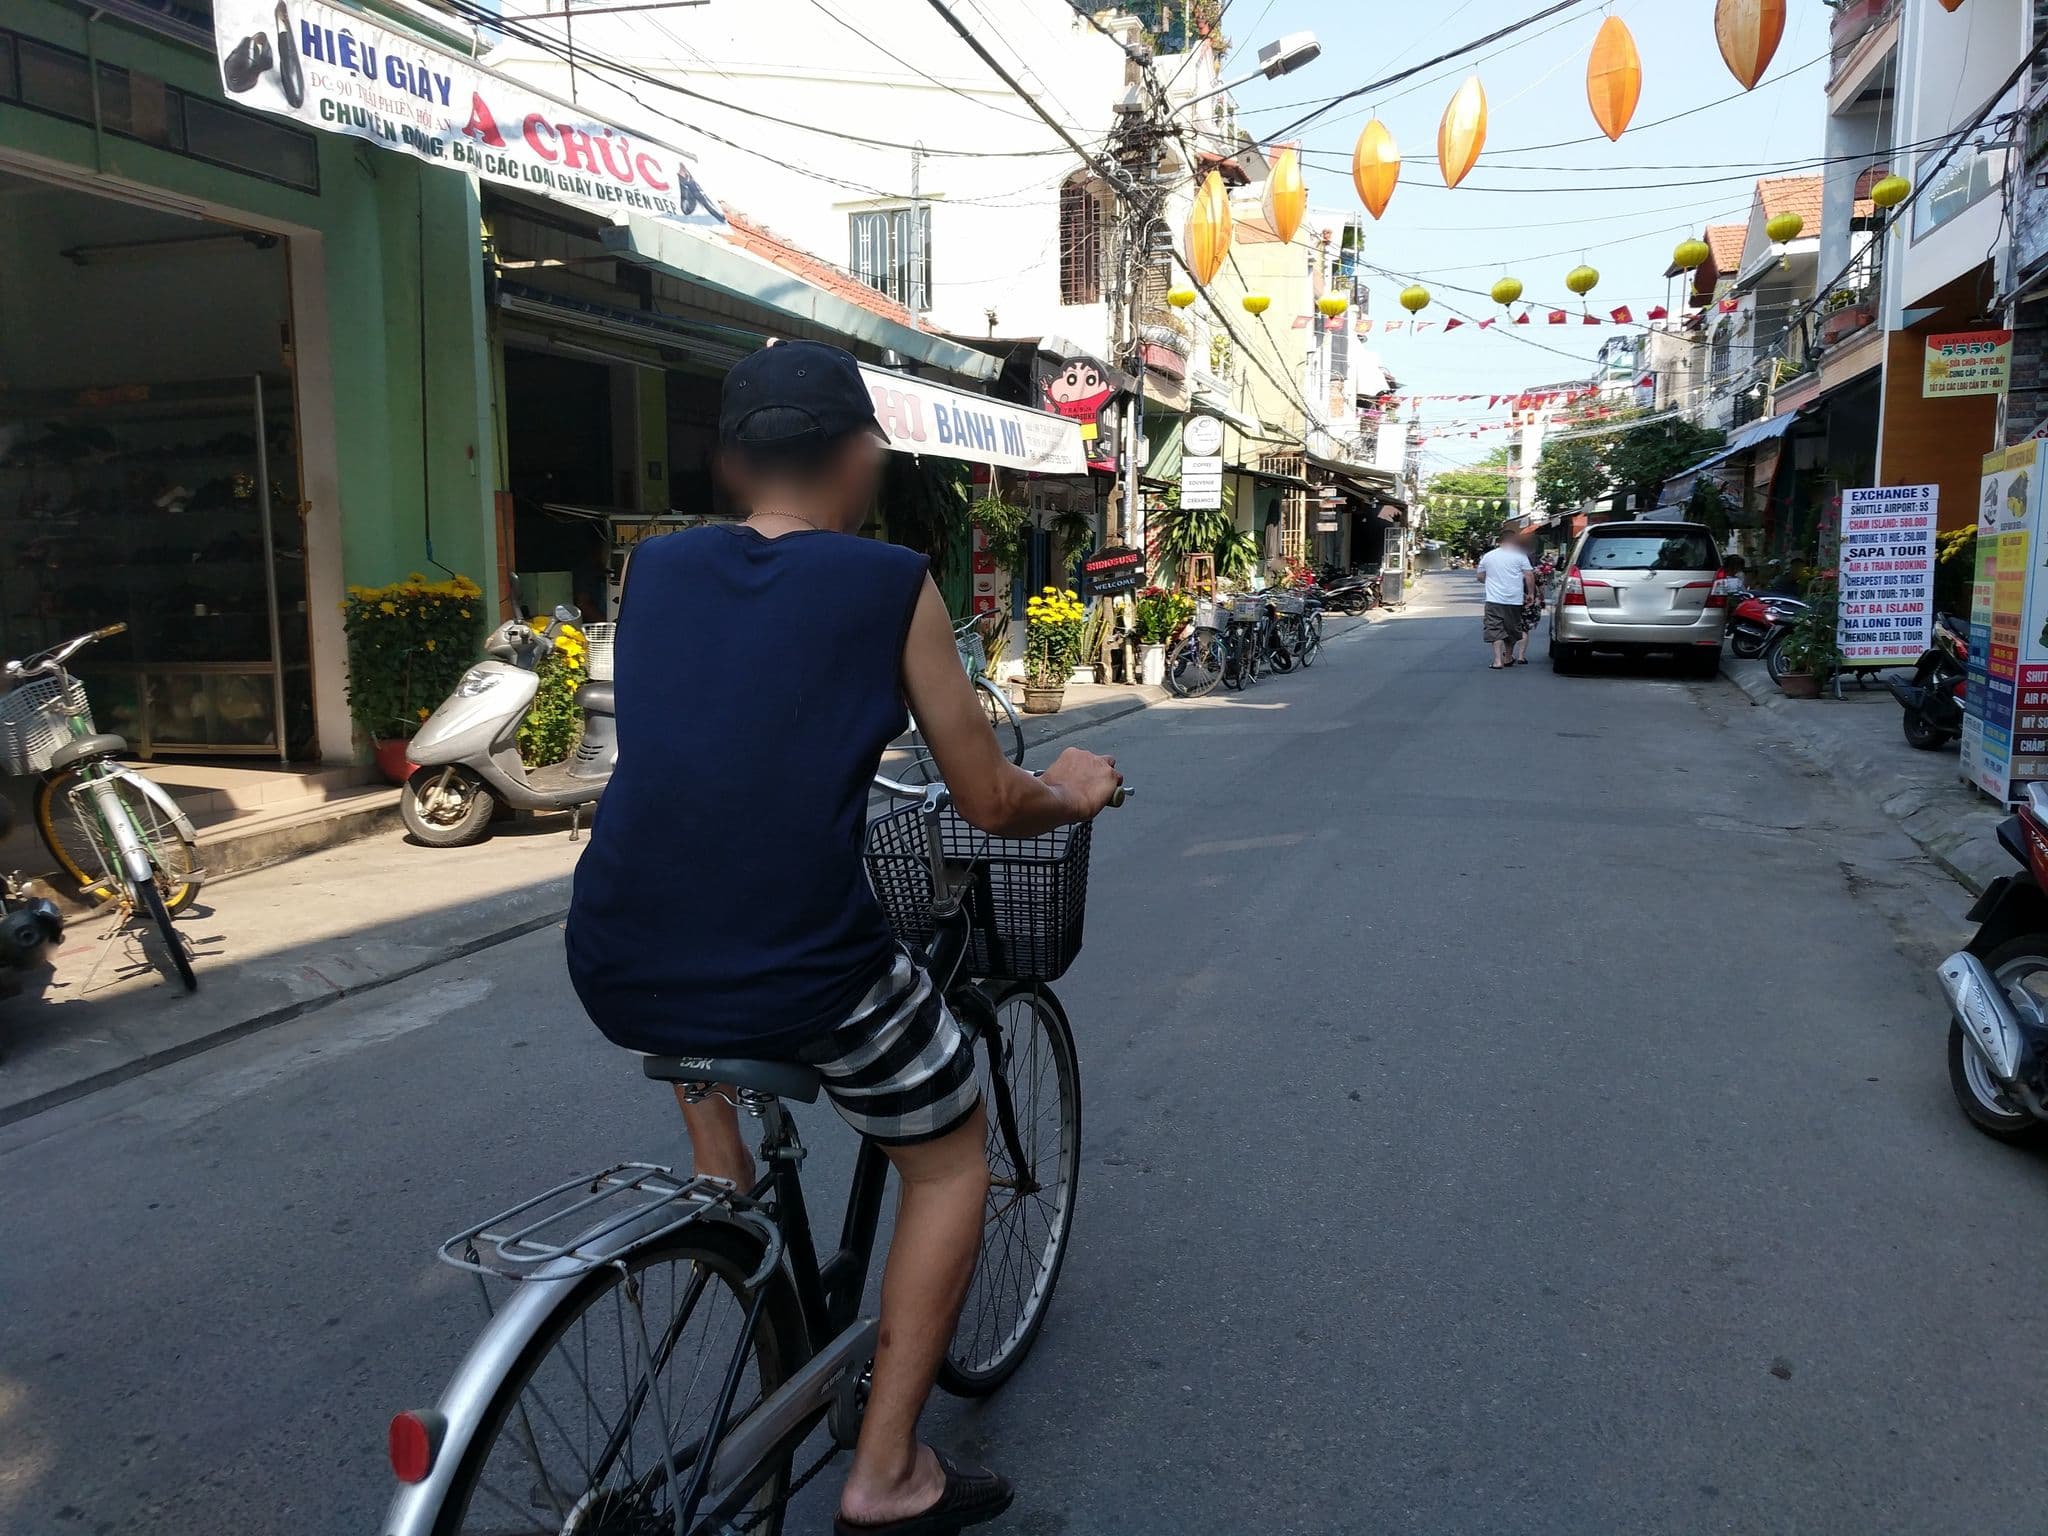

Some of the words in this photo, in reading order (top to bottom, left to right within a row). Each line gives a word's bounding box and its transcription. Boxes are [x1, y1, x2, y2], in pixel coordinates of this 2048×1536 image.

[300, 19, 378, 81] HIỆU
[385, 54, 450, 107] GIÀY
[336, 80, 352, 97] 90
[320, 98, 397, 142] CHUYÊN
[486, 153, 519, 179] CÁC
[523, 113, 670, 191] CHỨC
[1942, 342, 1996, 356] 5559
[934, 399, 997, 452] BÁNH
[1000, 414, 1026, 458] MÌ
[1852, 488, 1918, 501] EXCHANGE
[1851, 504, 1882, 516] SHUTTLE
[1884, 502, 1918, 514] AIRPORT:
[1880, 533, 1888, 542] TO
[1849, 547, 1886, 558] SAPA
[1890, 546, 1927, 556] TOUR
[1086, 553, 1138, 571] SHINOSUKE
[1872, 561, 1892, 572] TRAIN
[1894, 560, 1928, 570] BOOKING
[1094, 577, 1136, 592] WELCOME
[1847, 575, 1882, 586] CHEAPEST
[1884, 575, 1898, 585] BUS
[1900, 574, 1924, 584] TICKET
[1847, 604, 1866, 614] CAT
[1868, 604, 1882, 614] BA
[1886, 602, 1924, 613] ISLAND
[1844, 619, 1859, 628] HA
[1862, 618, 1891, 628] LONG
[1894, 617, 1922, 627] TOUR
[1845, 632, 1877, 642] MEKONG
[1879, 632, 1900, 642] DELTA
[1903, 631, 1923, 640] TOUR
[1844, 647, 1856, 656] CU
[1858, 646, 1872, 656] CHI
[1874, 646, 1880, 655] &
[1882, 646, 1900, 655] PHU
[1901, 645, 1924, 654] QUOC
[2024, 692, 2039, 704] AIR
[2040, 692, 2048, 704] P
